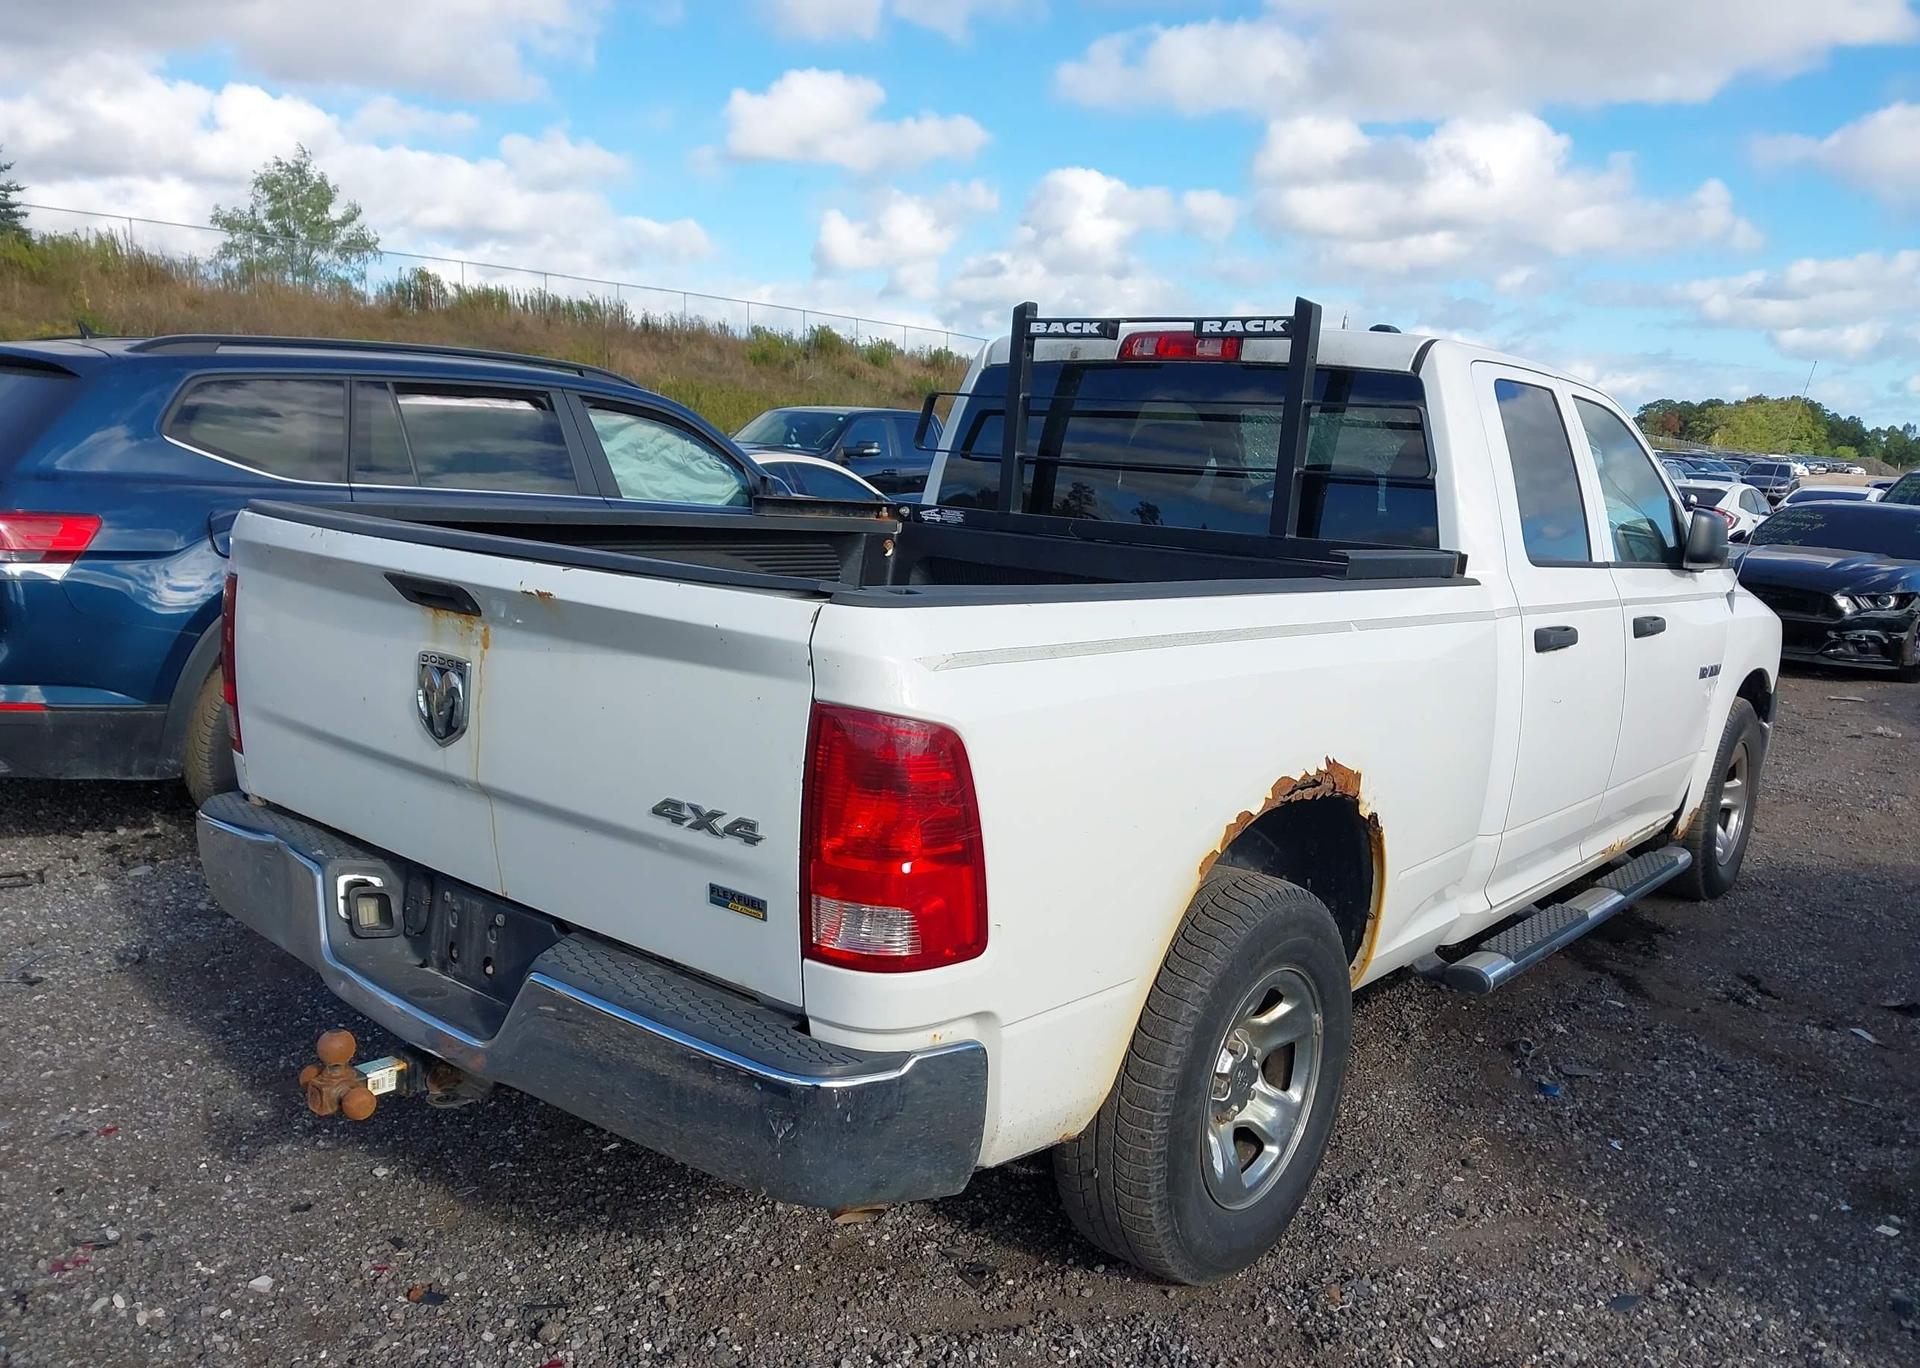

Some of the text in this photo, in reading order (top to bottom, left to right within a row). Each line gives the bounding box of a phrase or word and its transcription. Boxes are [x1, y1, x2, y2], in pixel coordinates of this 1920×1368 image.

[1029, 319, 1287, 334] BACK RACK
[421, 654, 463, 670] DODGE
[652, 798, 766, 847] 4X4
